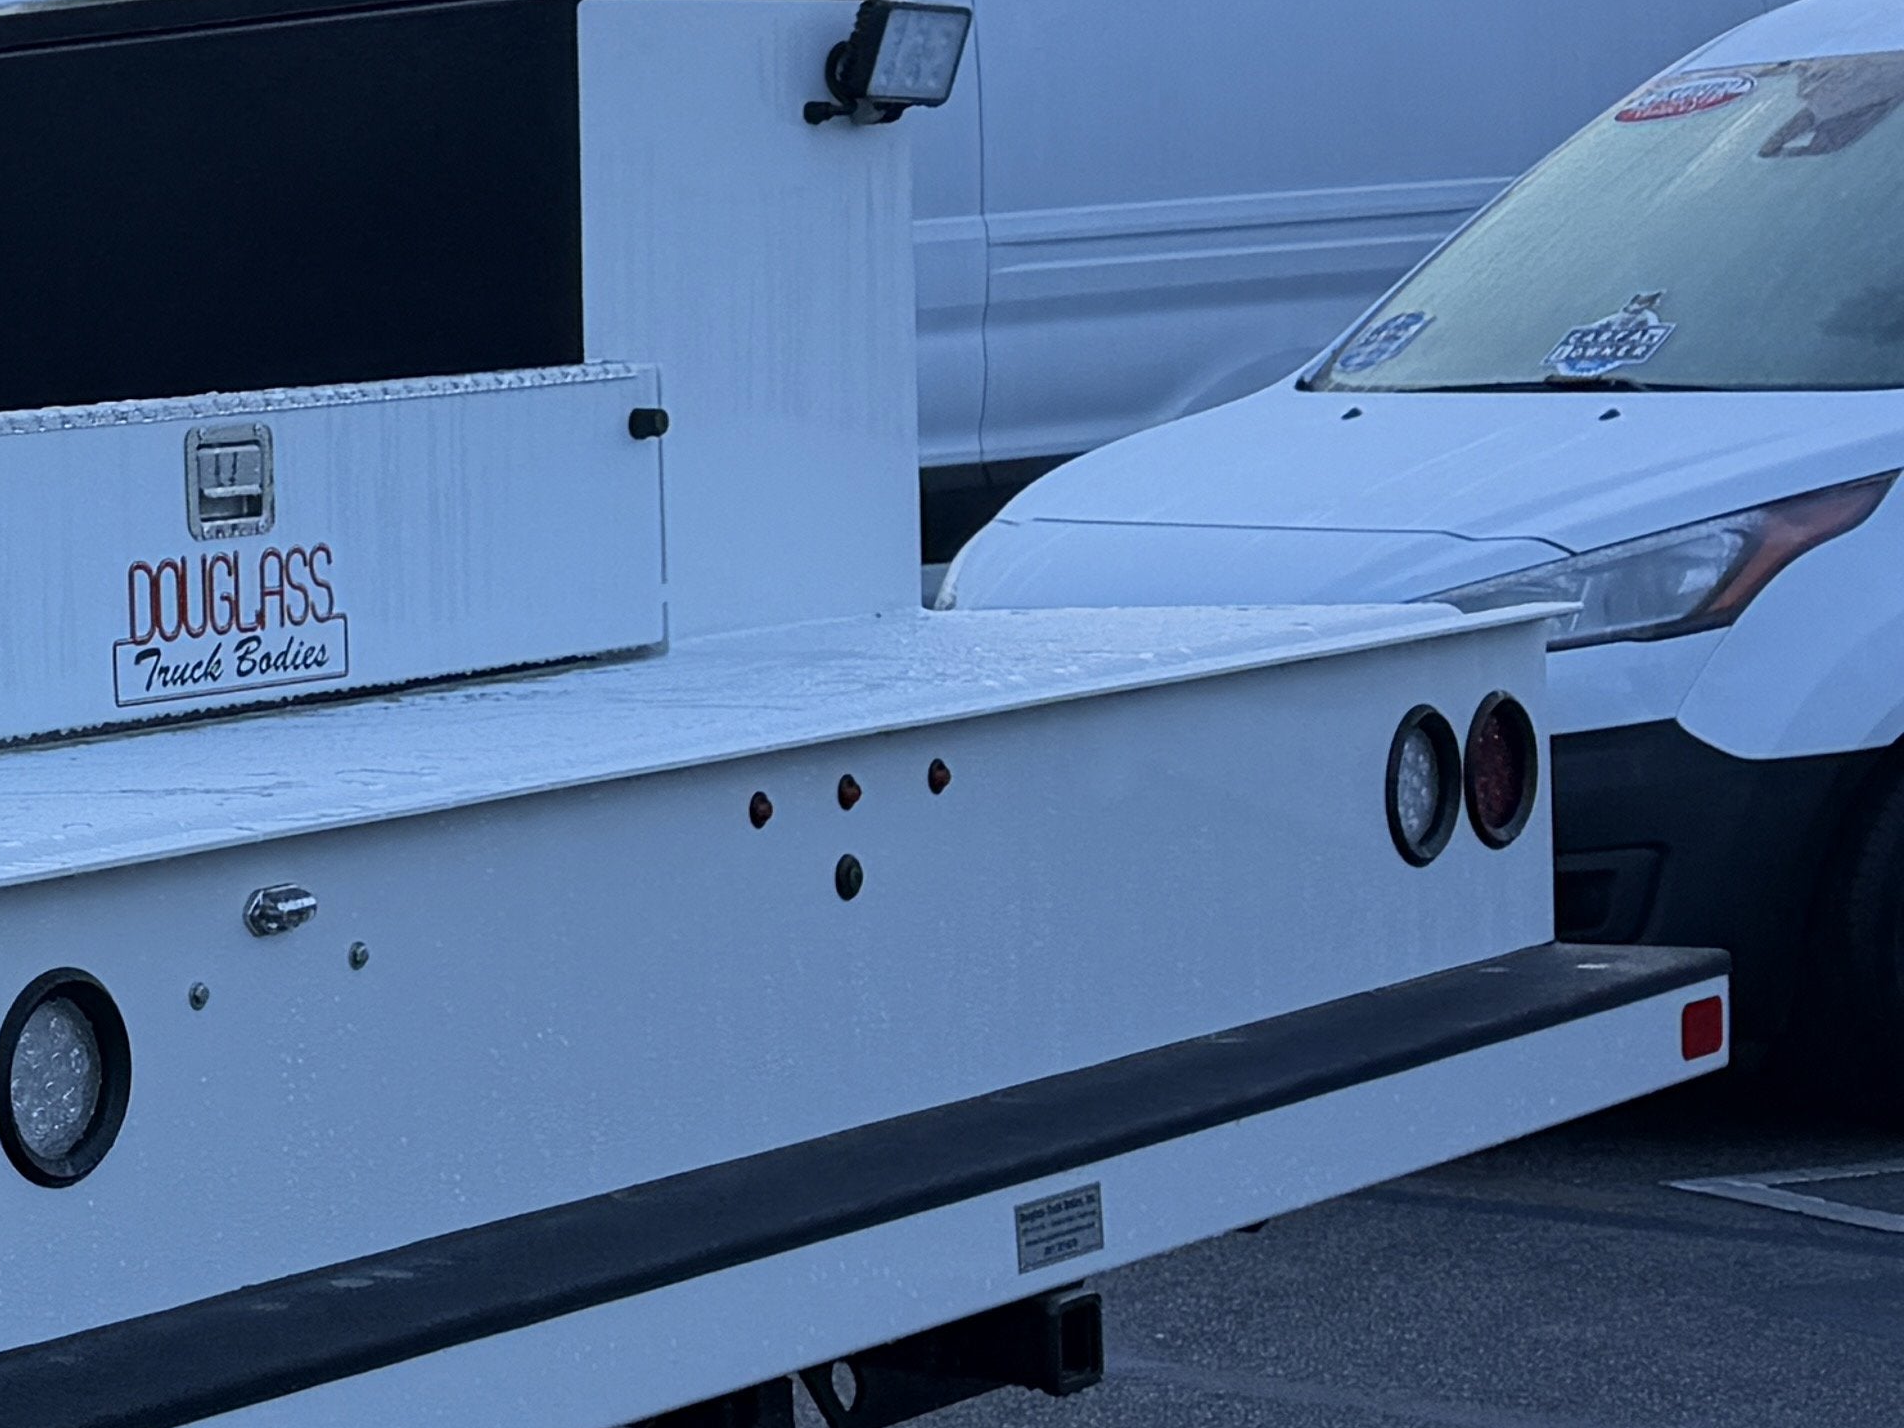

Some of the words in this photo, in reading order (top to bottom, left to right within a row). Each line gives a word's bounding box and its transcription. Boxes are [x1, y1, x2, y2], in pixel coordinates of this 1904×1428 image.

[128, 542, 334, 646] DOUGLASS
[134, 642, 224, 692] Truck
[233, 634, 330, 677] Bodies
